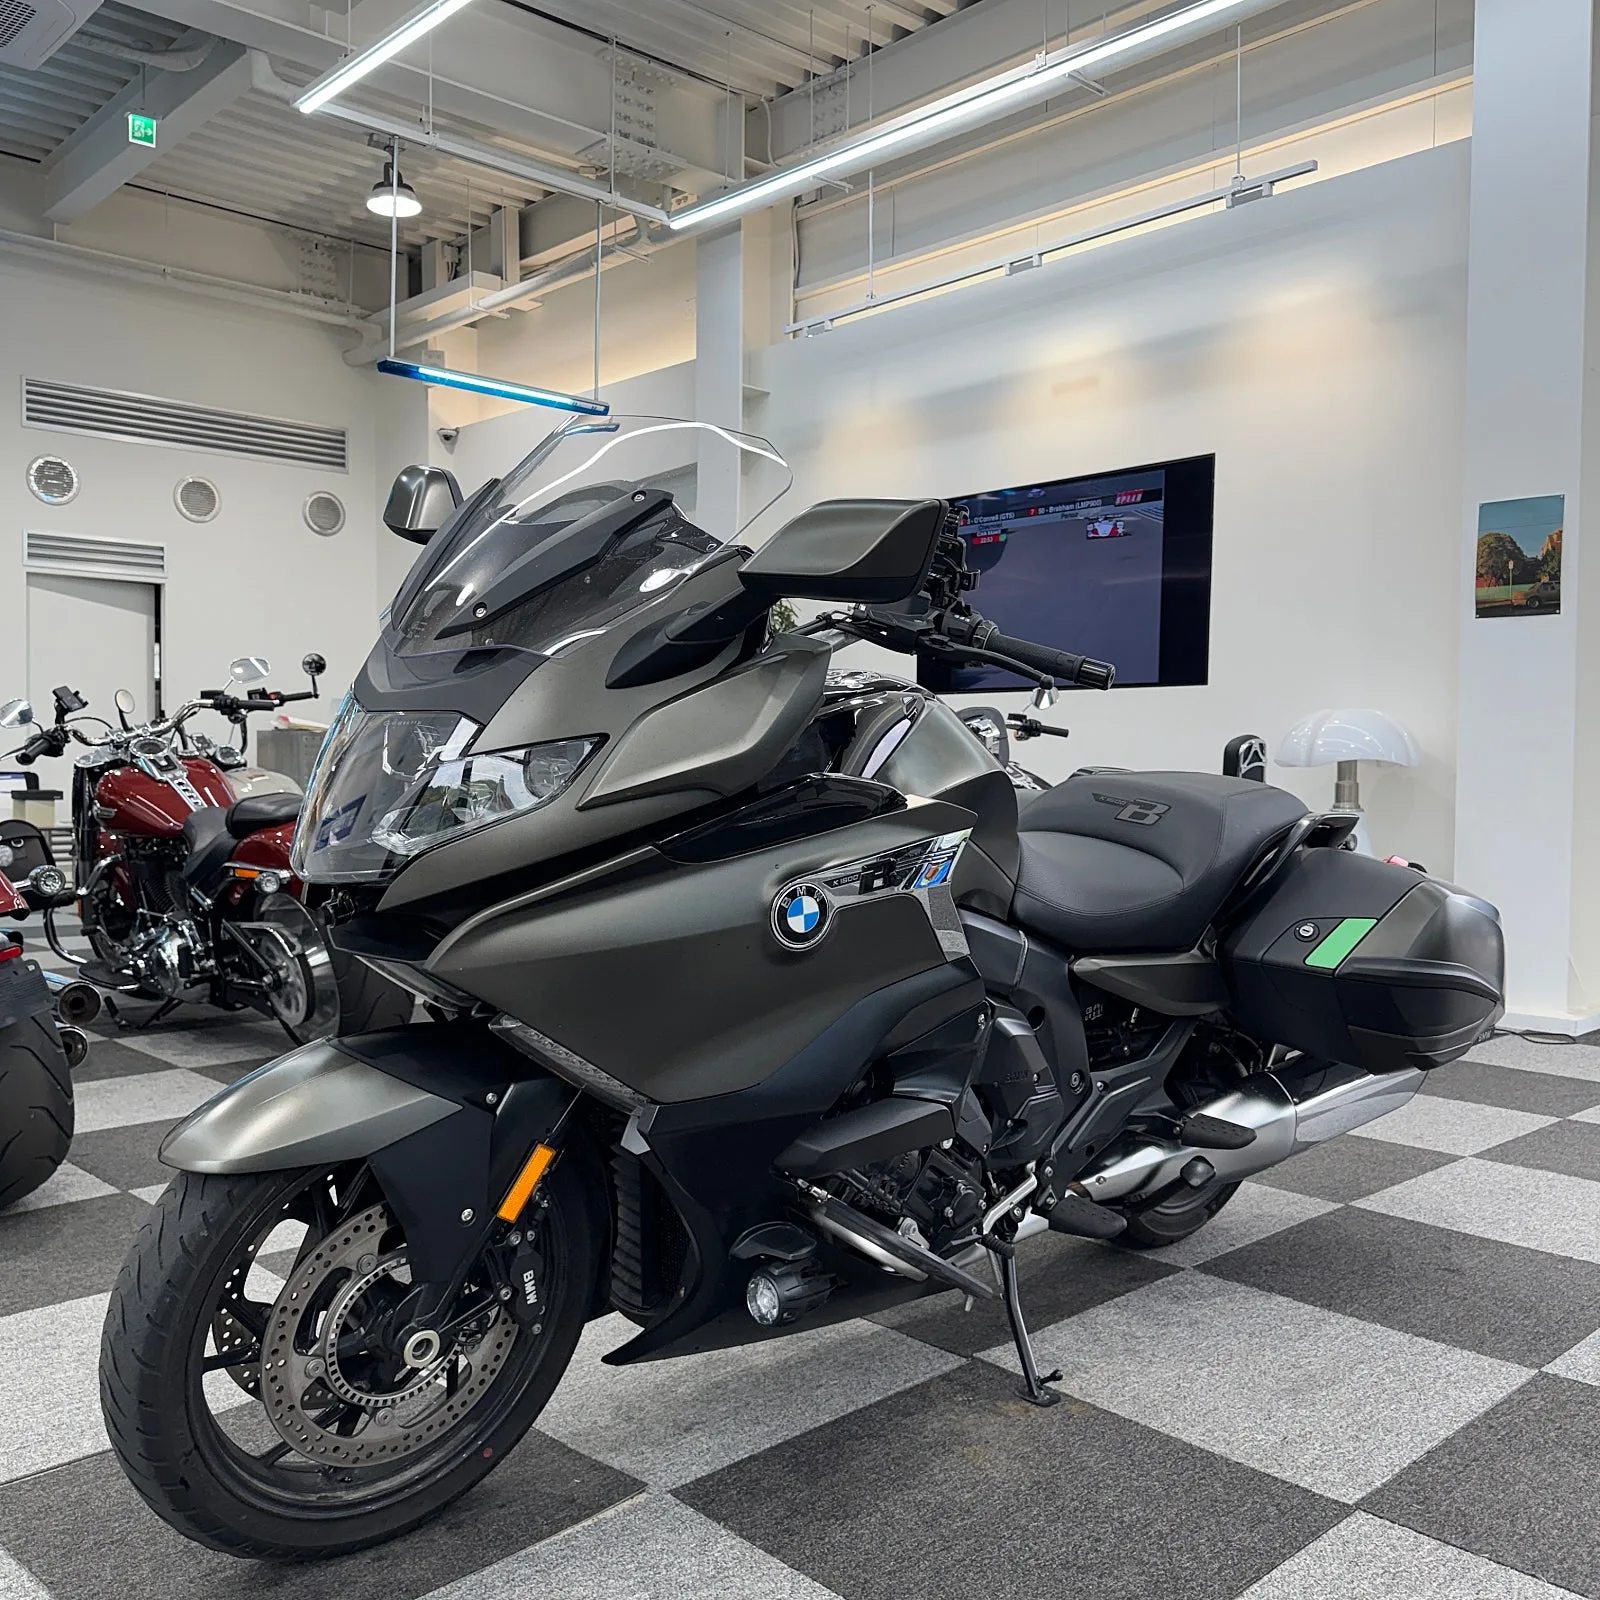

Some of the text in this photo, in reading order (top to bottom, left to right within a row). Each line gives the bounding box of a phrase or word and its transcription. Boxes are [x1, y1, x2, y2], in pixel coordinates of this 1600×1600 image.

[1114, 798, 1171, 826] B
[781, 886, 824, 909] BMW
[523, 1269, 538, 1305] BMW
